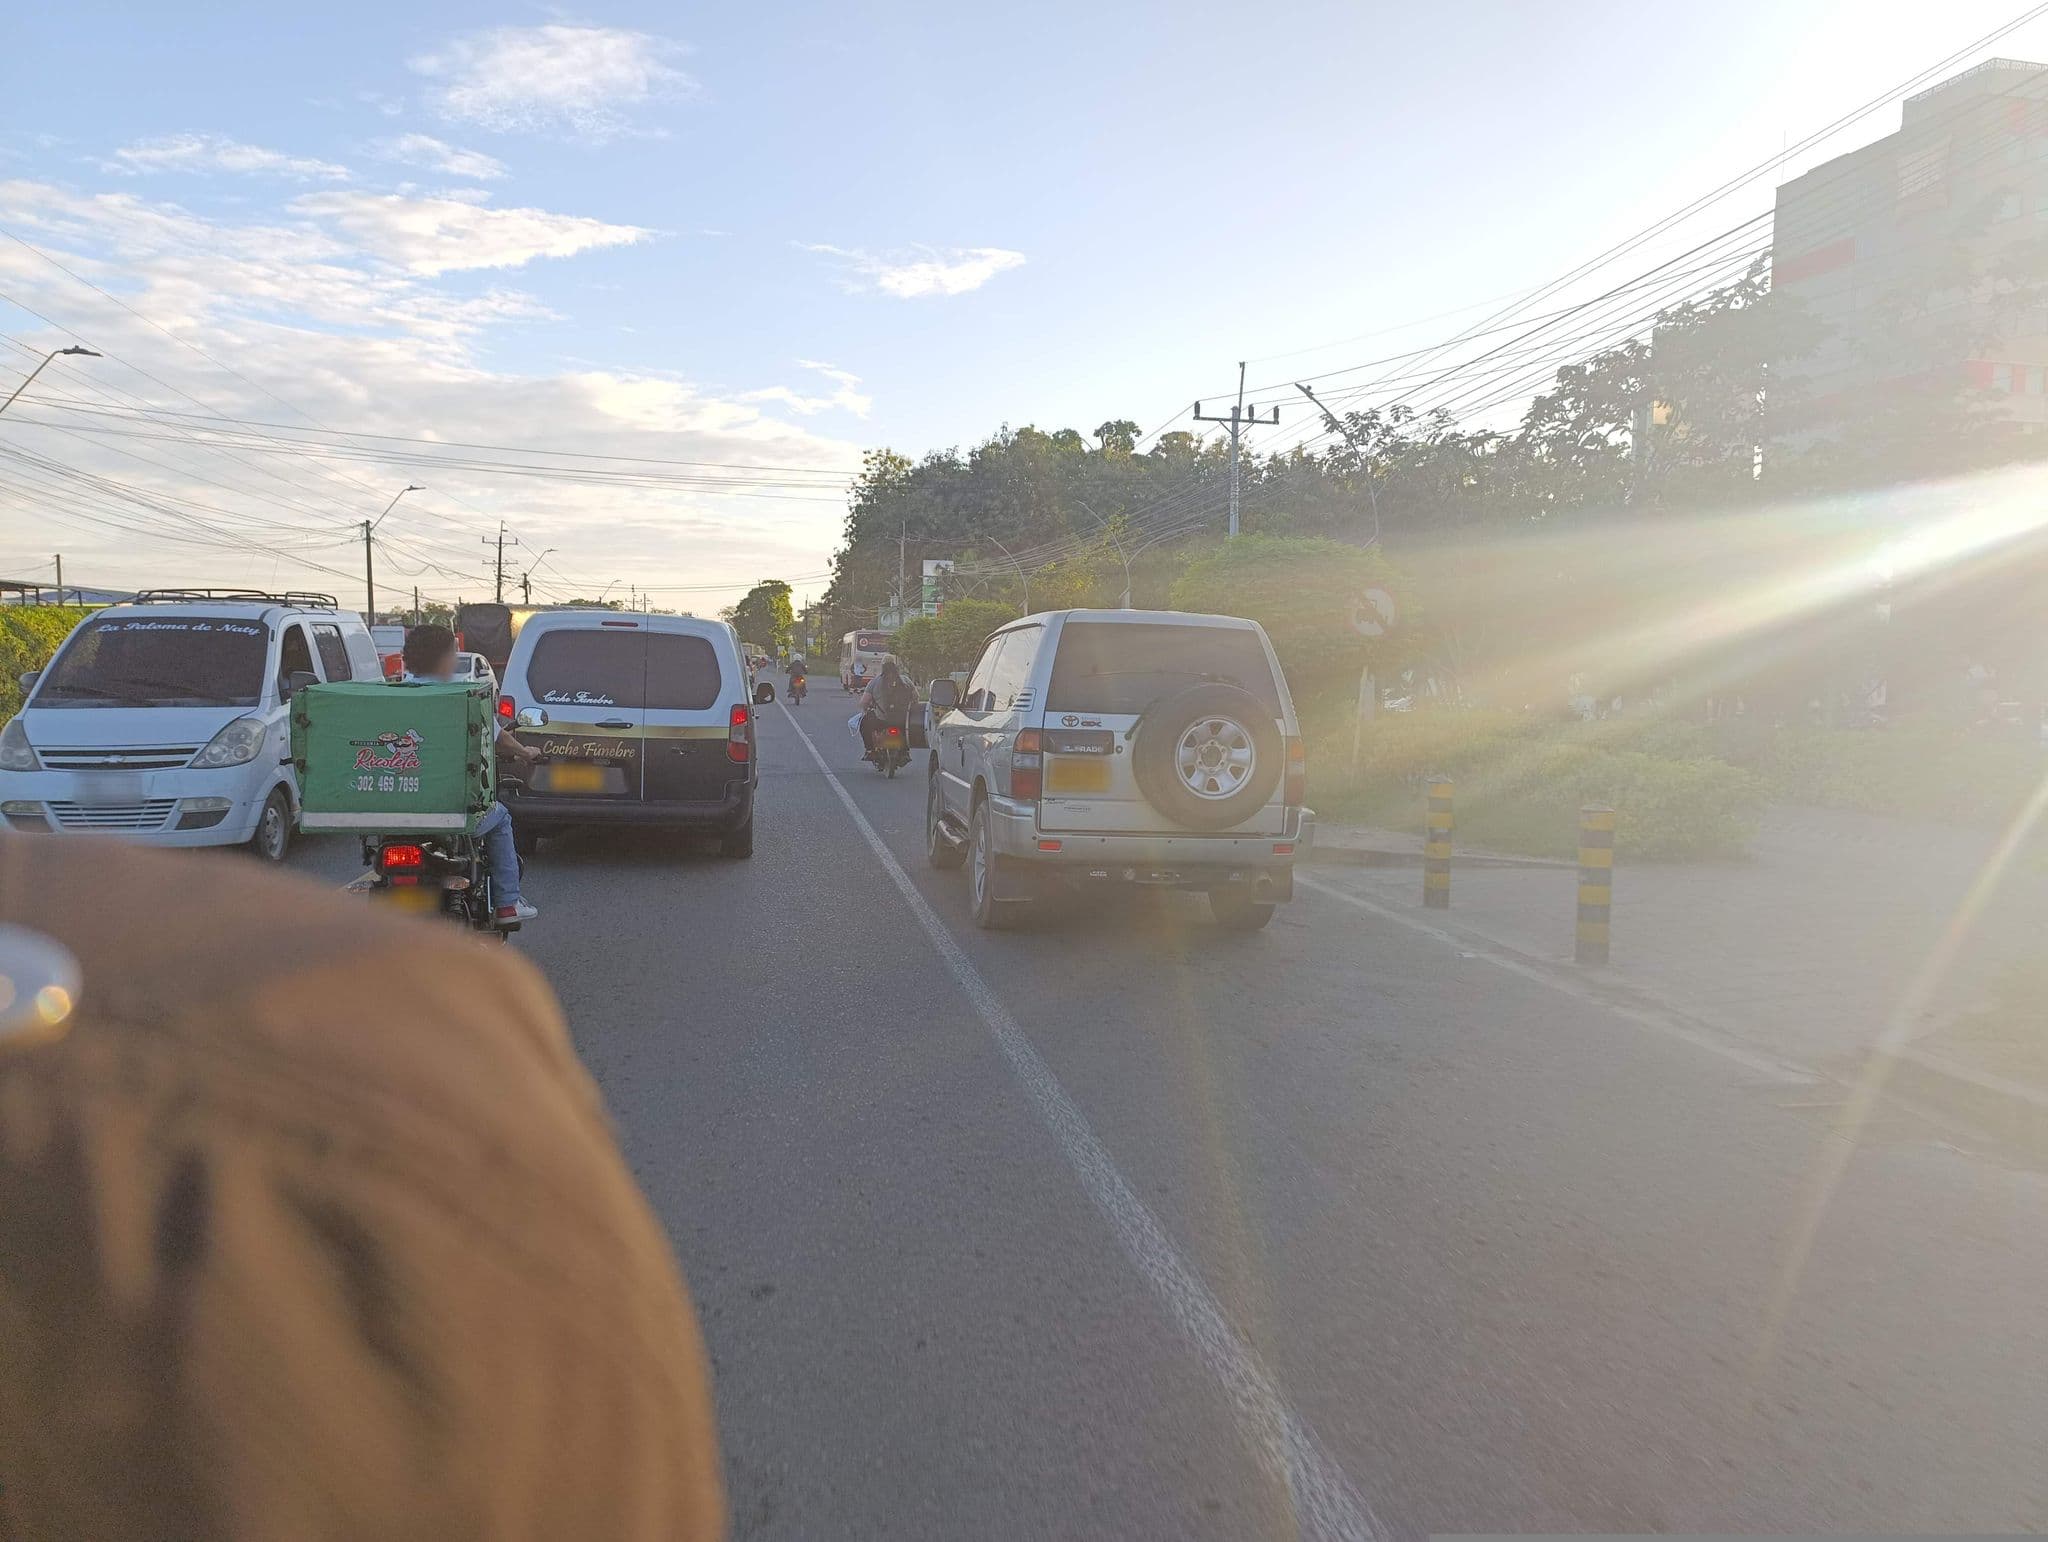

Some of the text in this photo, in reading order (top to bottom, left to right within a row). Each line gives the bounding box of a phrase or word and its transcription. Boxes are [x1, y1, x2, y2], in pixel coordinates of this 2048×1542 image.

[96, 622, 260, 635] La Paloma de Naty
[543, 690, 571, 703] Coche
[542, 738, 636, 758] Coche Fúnebre
[357, 775, 374, 791] 302
[377, 775, 395, 792] 469
